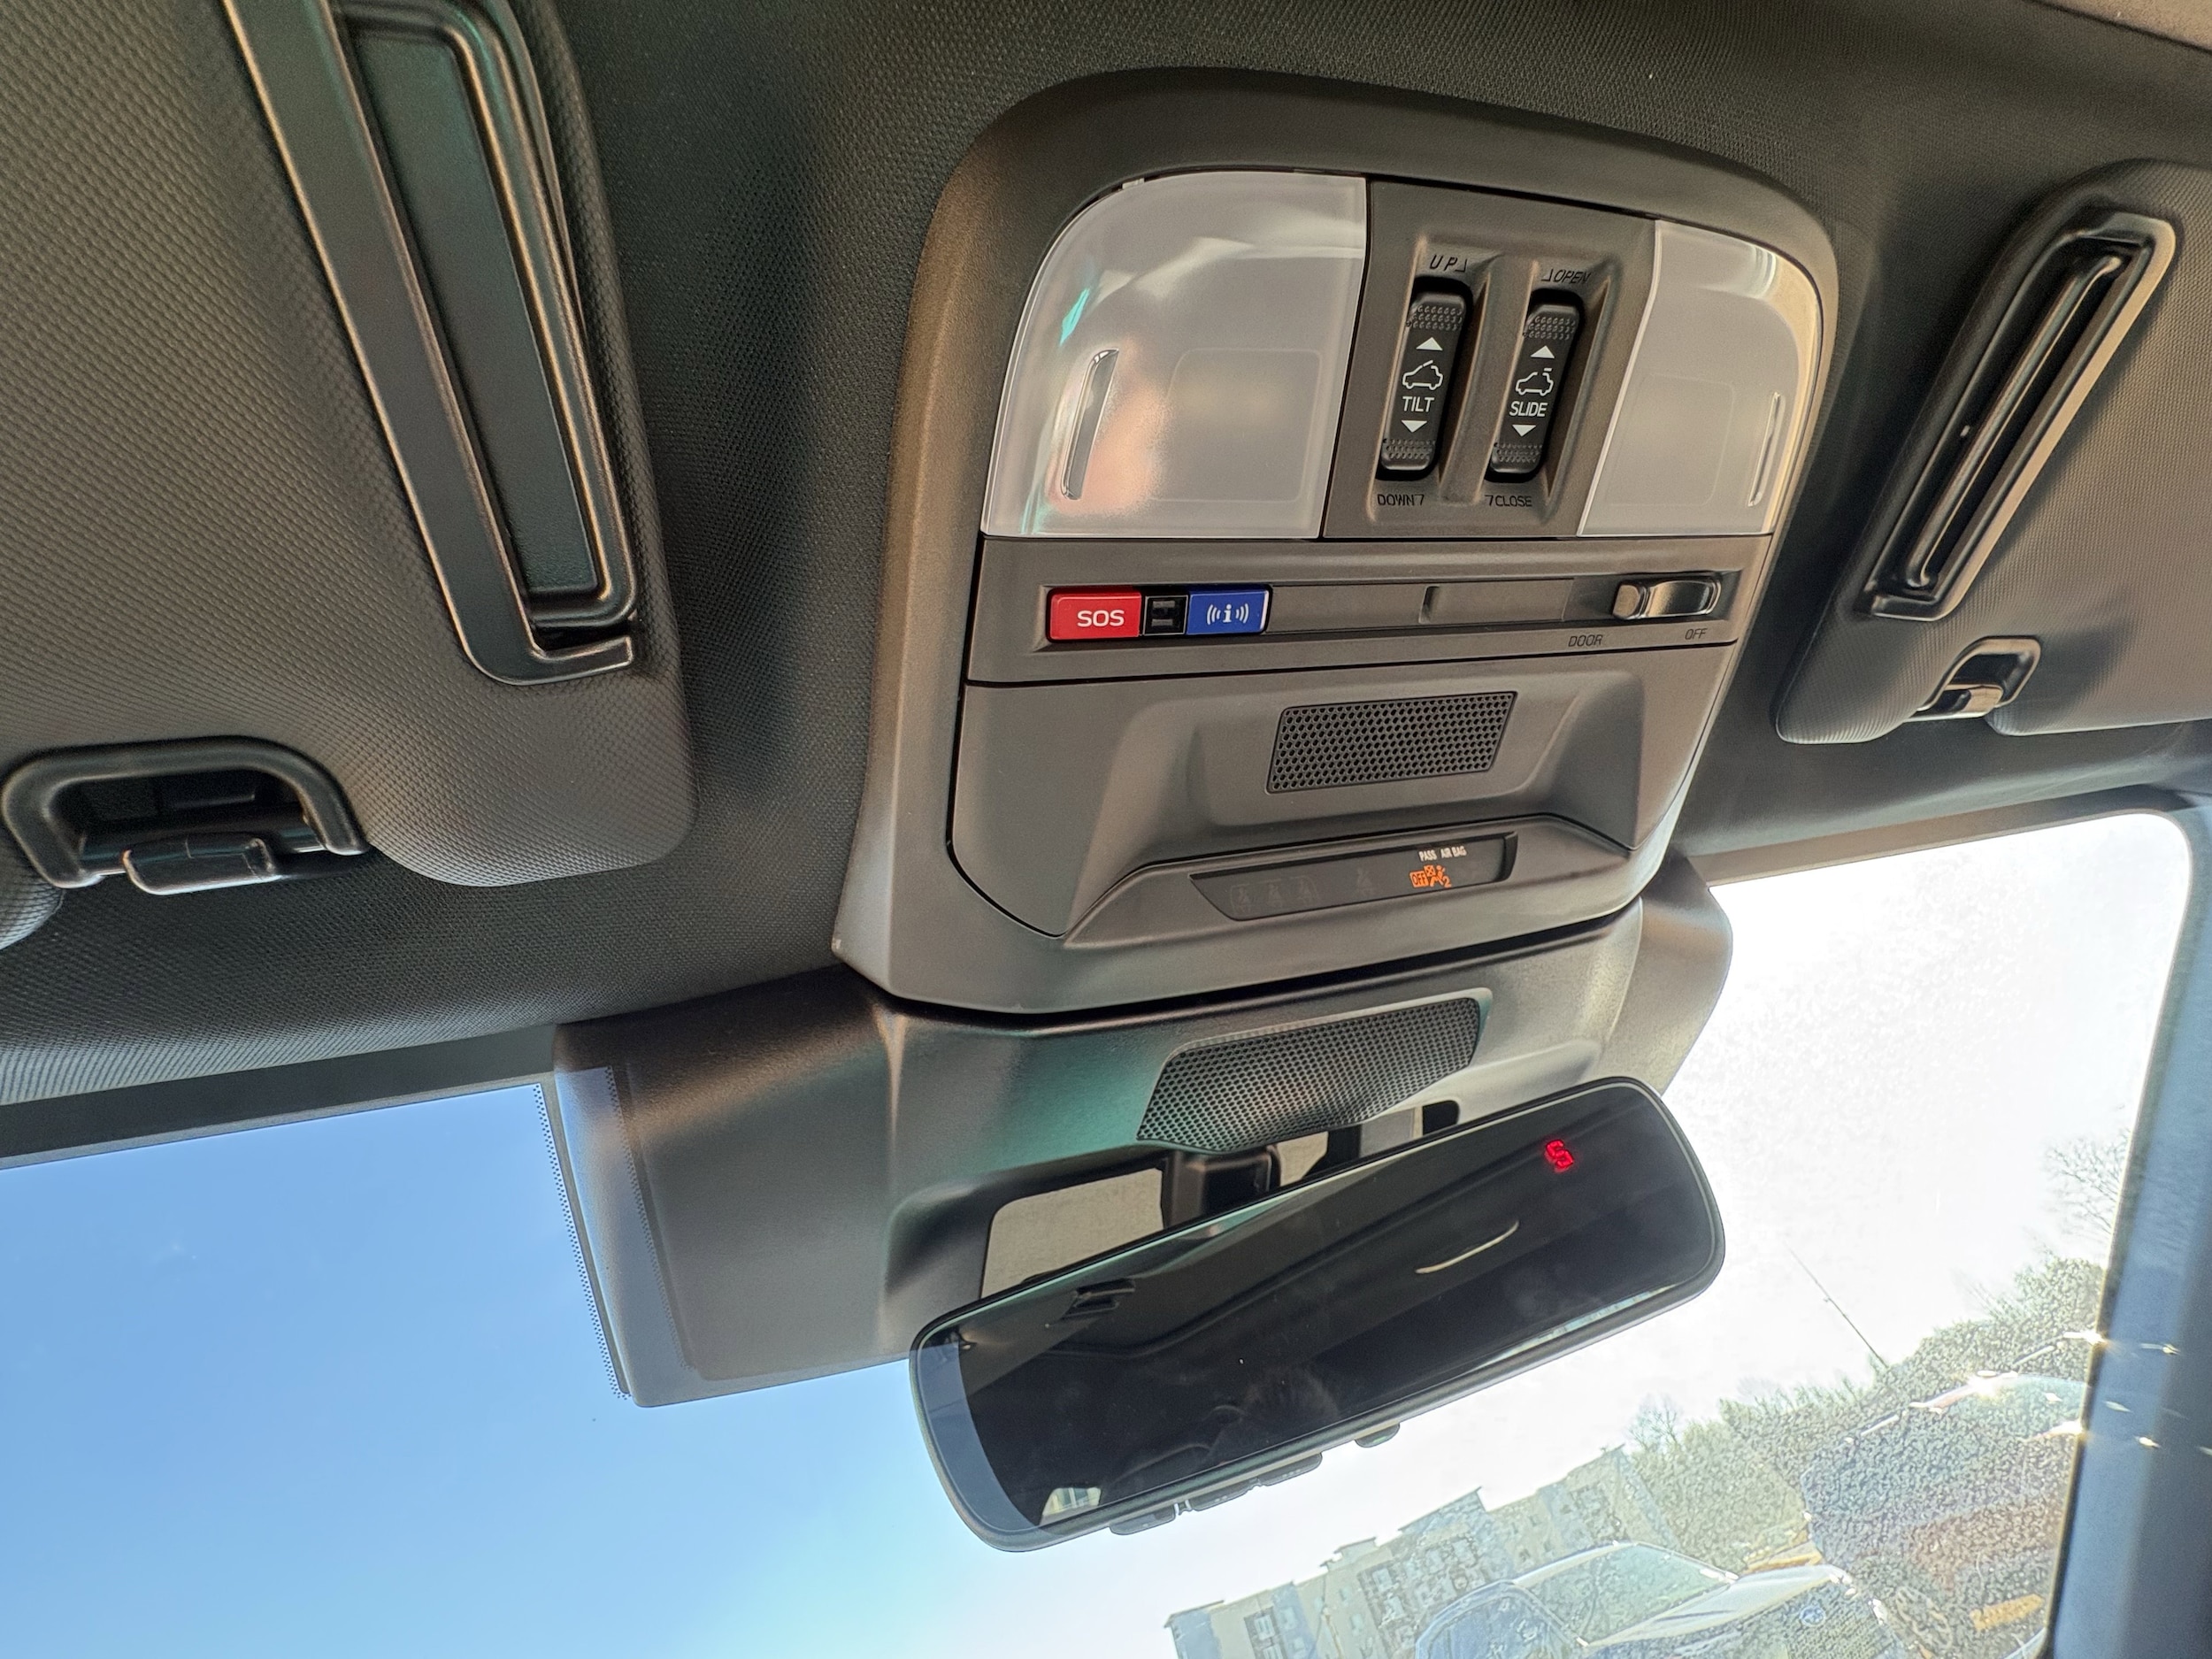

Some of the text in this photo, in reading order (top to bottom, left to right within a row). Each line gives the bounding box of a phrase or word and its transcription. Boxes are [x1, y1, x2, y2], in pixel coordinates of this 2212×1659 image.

[1429, 254, 1458, 271] UP
[1553, 268, 1591, 285] OPEN
[1402, 396, 1435, 412] TILT
[1509, 400, 1548, 418] SLIDE
[1377, 494, 1416, 507] DOWN
[1494, 495, 1533, 508] CLOSE
[1076, 609, 1125, 627] SOS
[1568, 634, 1604, 648] DOOR
[1684, 627, 1708, 641] OFF
[1418, 849, 1438, 862] PASS
[1411, 872, 1426, 886] OFF
